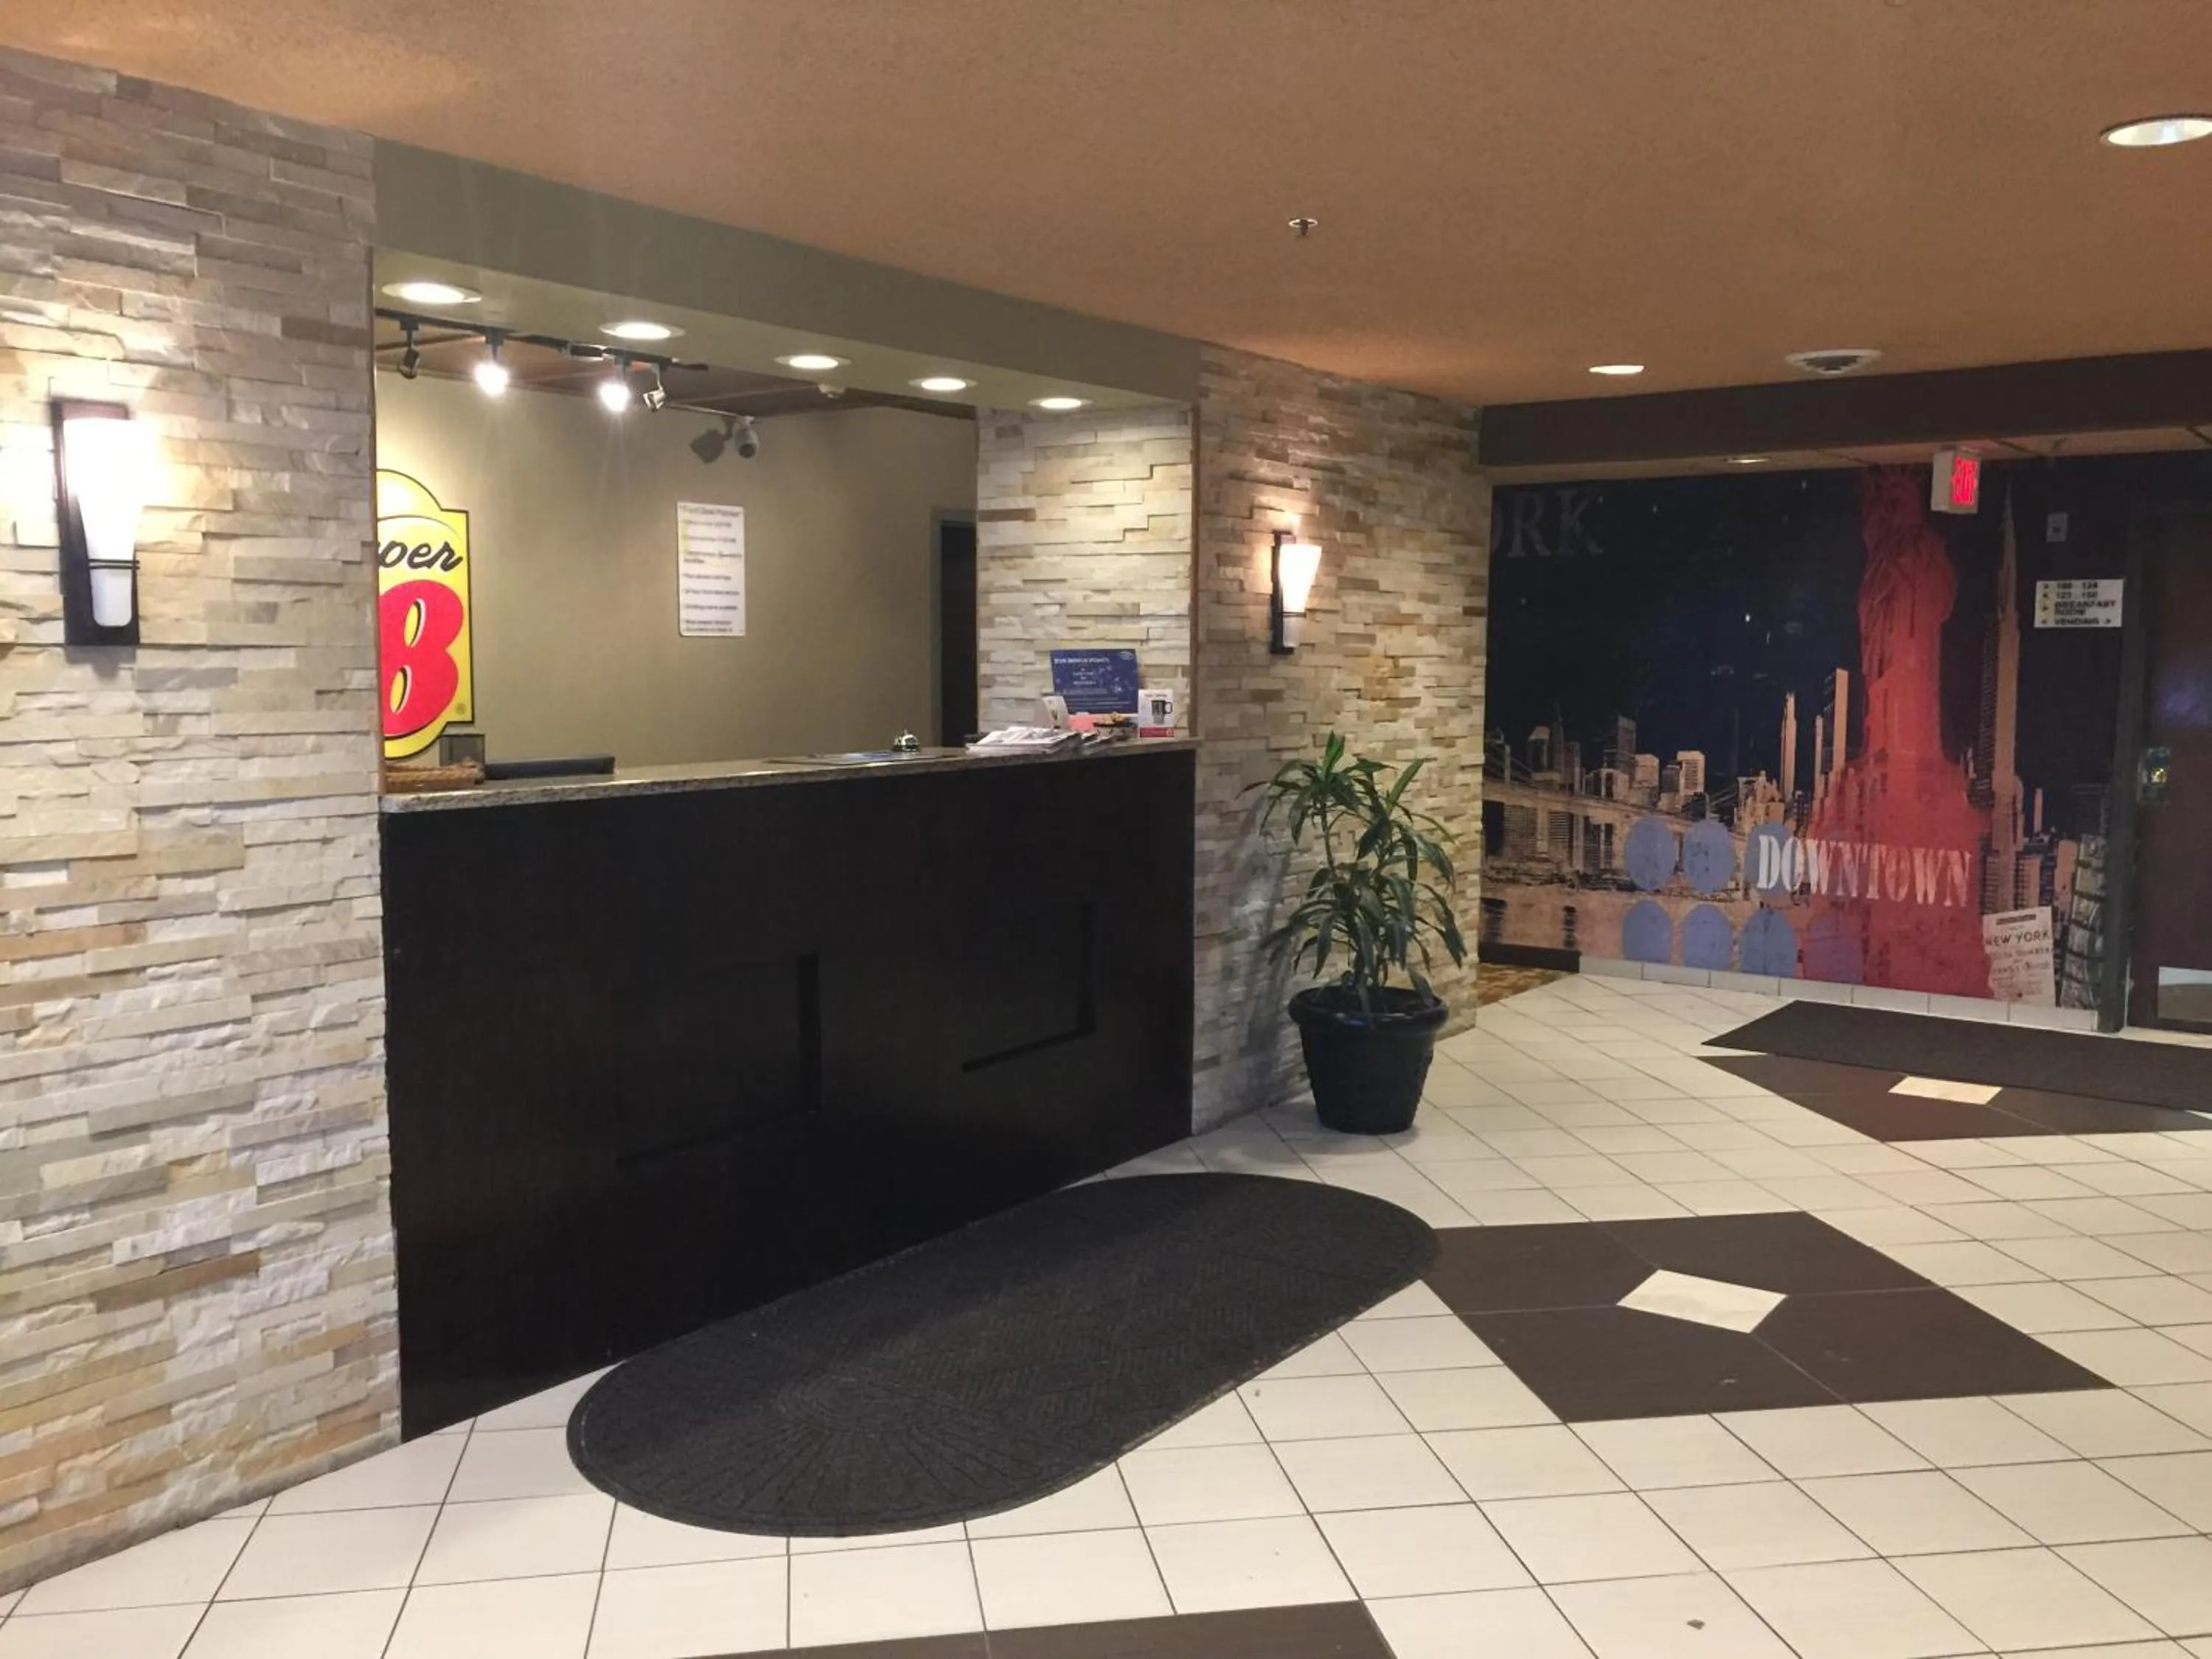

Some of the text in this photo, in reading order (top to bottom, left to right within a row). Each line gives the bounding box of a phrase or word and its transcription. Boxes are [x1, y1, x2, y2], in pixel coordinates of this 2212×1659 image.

[1492, 487, 1604, 558] RK
[1757, 835, 1972, 908] DOWNTOWN
[2016, 930, 2050, 945] YORK
